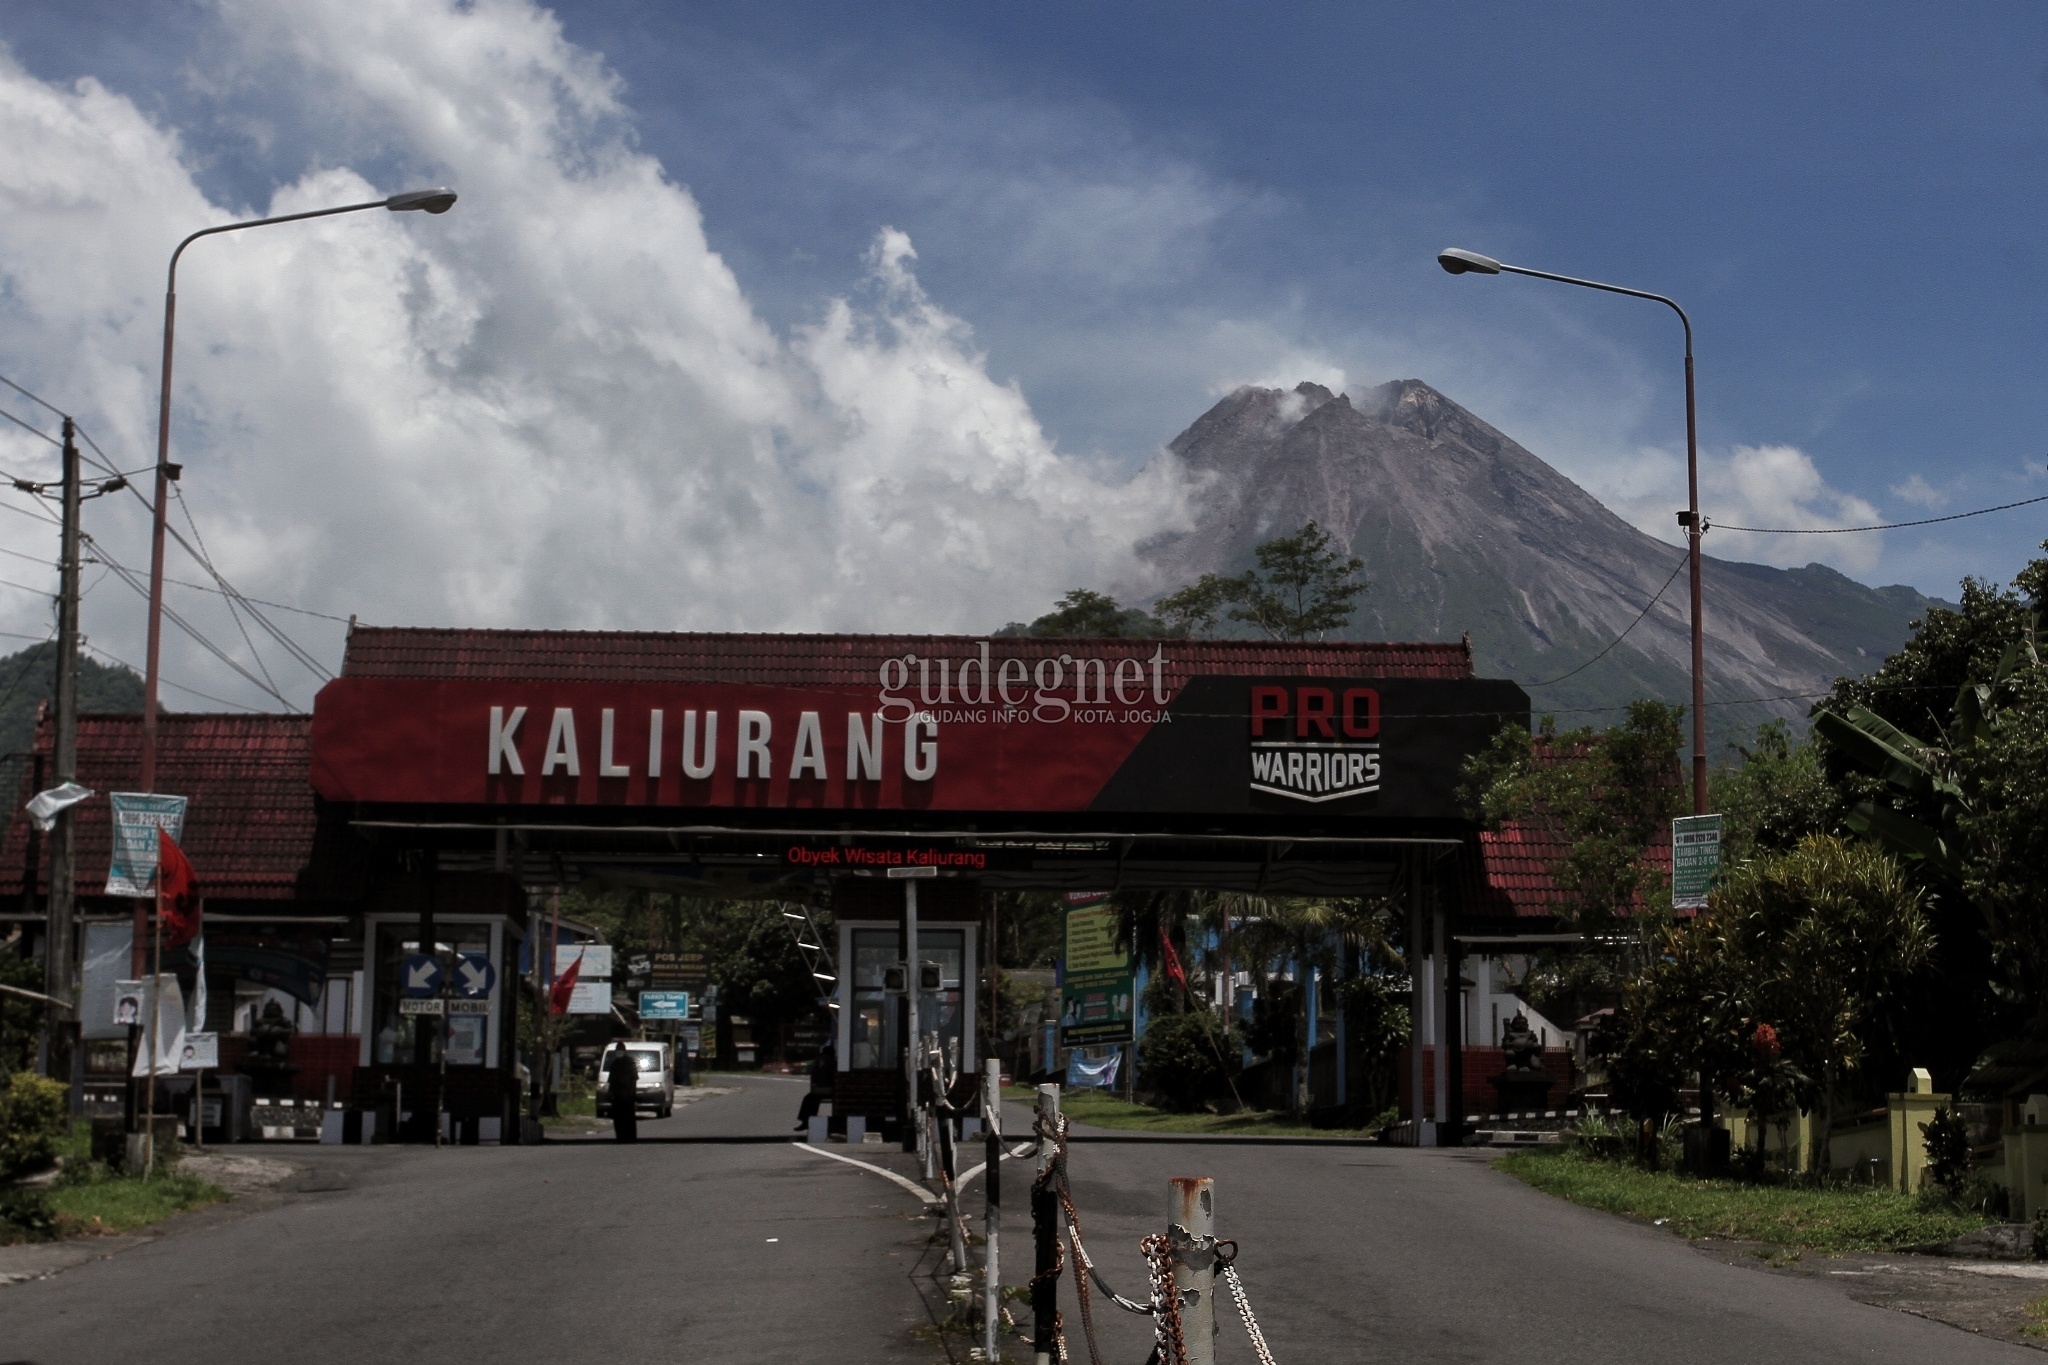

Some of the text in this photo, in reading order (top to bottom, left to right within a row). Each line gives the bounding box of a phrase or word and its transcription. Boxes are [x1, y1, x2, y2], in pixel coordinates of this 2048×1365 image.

[1251, 686, 1380, 738] PRO
[487, 706, 938, 781] KALIURANG
[1251, 752, 1381, 792] WARRIORS
[788, 846, 986, 869] Obyek Wisata Kaliurang
[1676, 844, 1719, 858] TAMBAH TINGGI
[1676, 855, 1719, 868] BADAN 2-8 CM
[655, 953, 704, 962] POS JEEP
[402, 1002, 489, 1012] MOTOR MOBIL
